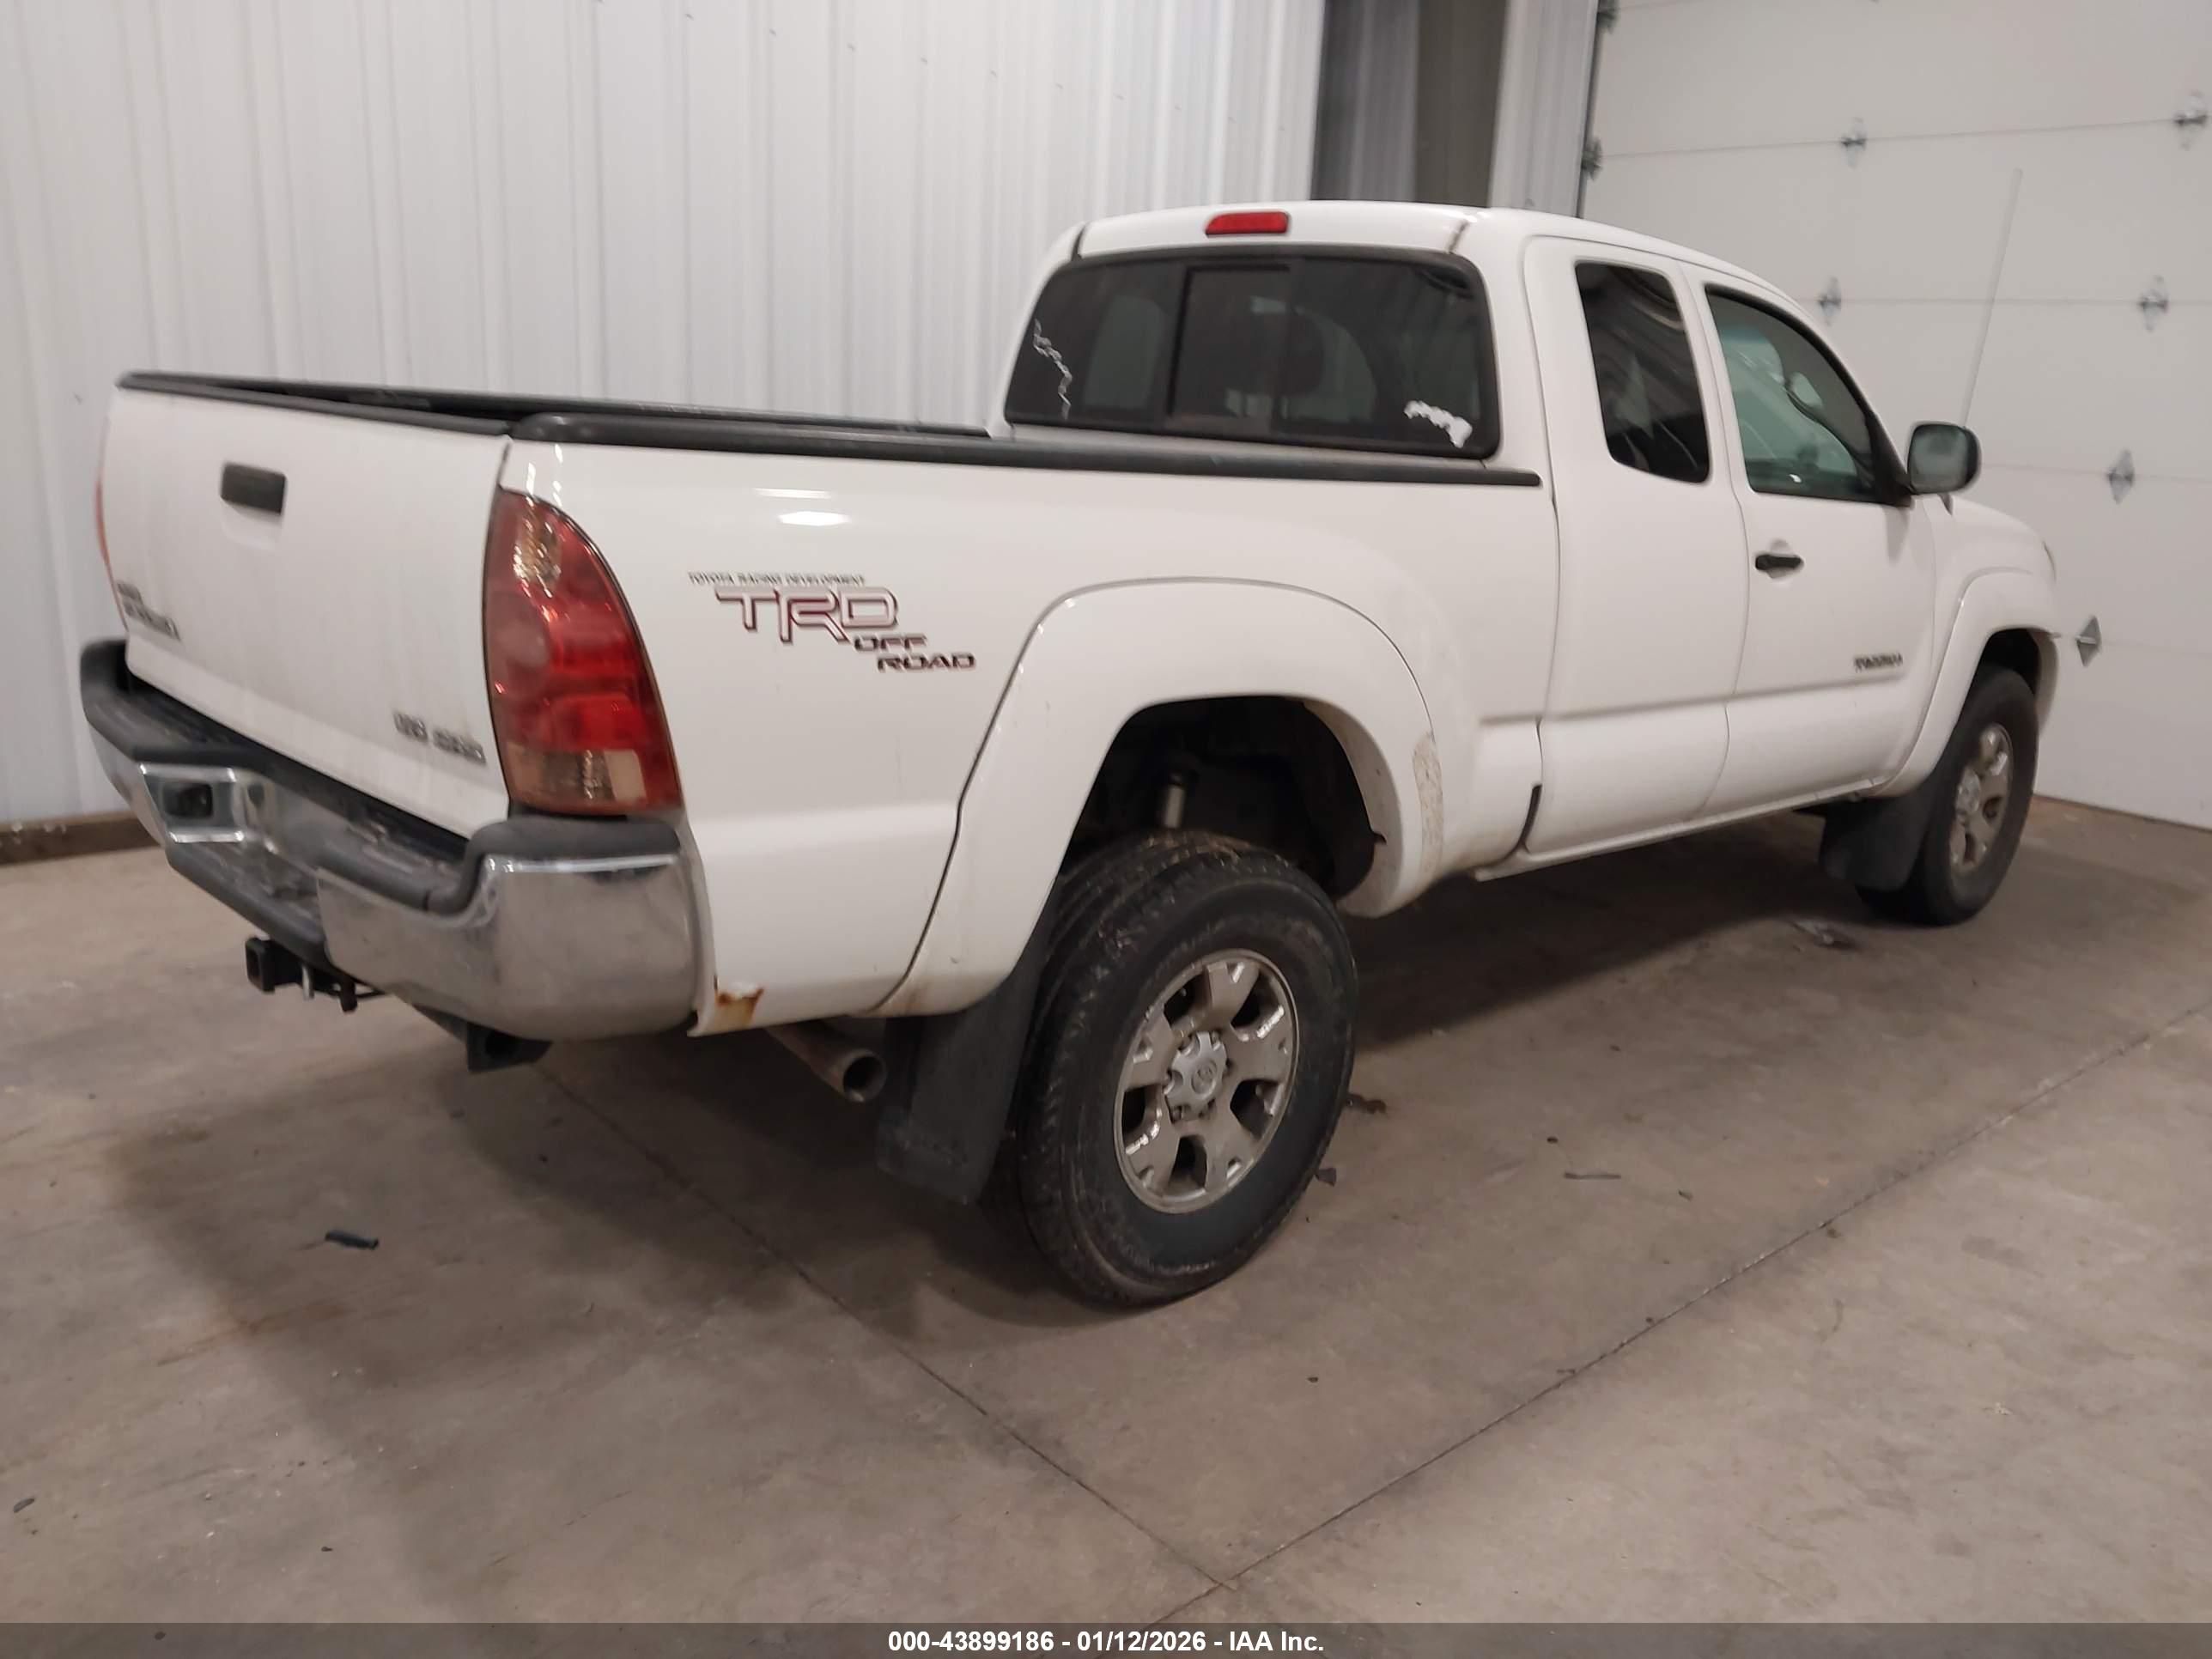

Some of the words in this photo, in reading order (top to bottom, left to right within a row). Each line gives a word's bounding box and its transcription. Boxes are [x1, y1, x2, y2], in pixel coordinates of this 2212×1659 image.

[714, 586, 898, 645] TRD
[854, 634, 927, 652] OFF
[877, 653, 975, 672] ROAD
